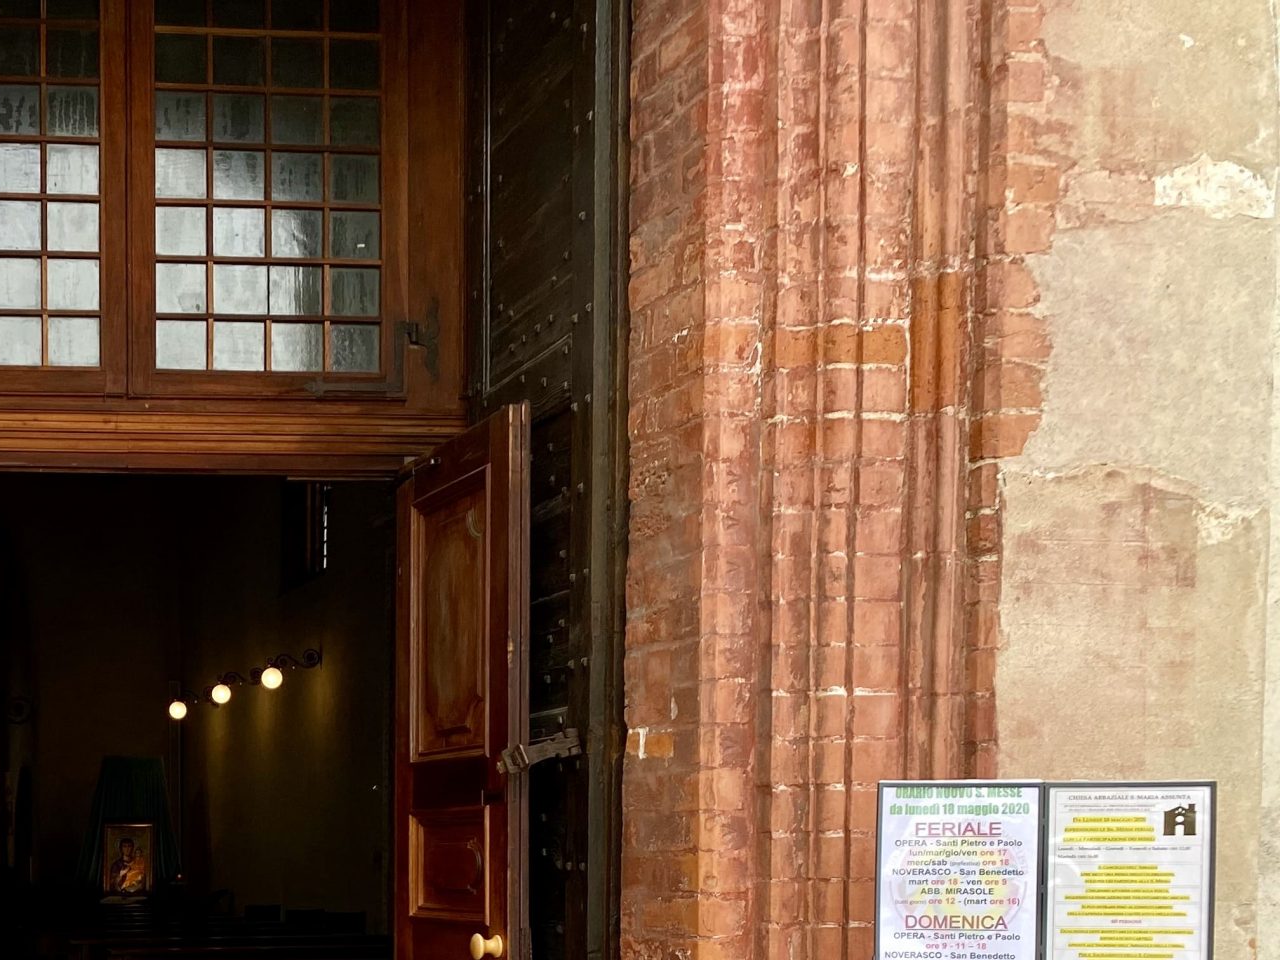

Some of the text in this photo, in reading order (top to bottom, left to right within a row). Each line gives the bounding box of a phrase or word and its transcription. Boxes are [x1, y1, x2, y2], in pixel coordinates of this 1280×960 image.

[987, 787, 1023, 798] MESSE
[890, 804, 903, 815] da
[942, 804, 955, 815] 18
[957, 803, 999, 816] maggio
[1002, 803, 1030, 815] 2020
[915, 822, 1002, 836] FERIALE
[935, 839, 958, 847] Santi
[960, 839, 987, 847] Pietro
[997, 839, 1023, 847] Paolo
[892, 868, 1024, 876] NOVERASCO San Benedetto
[963, 897, 987, 906] (mart
[905, 915, 1008, 930] DOMENICA
[894, 932, 925, 940] OPERA
[995, 933, 1020, 941] Paolo
[885, 951, 942, 959] NOVERASCO
[970, 952, 1016, 960] Benedetto
